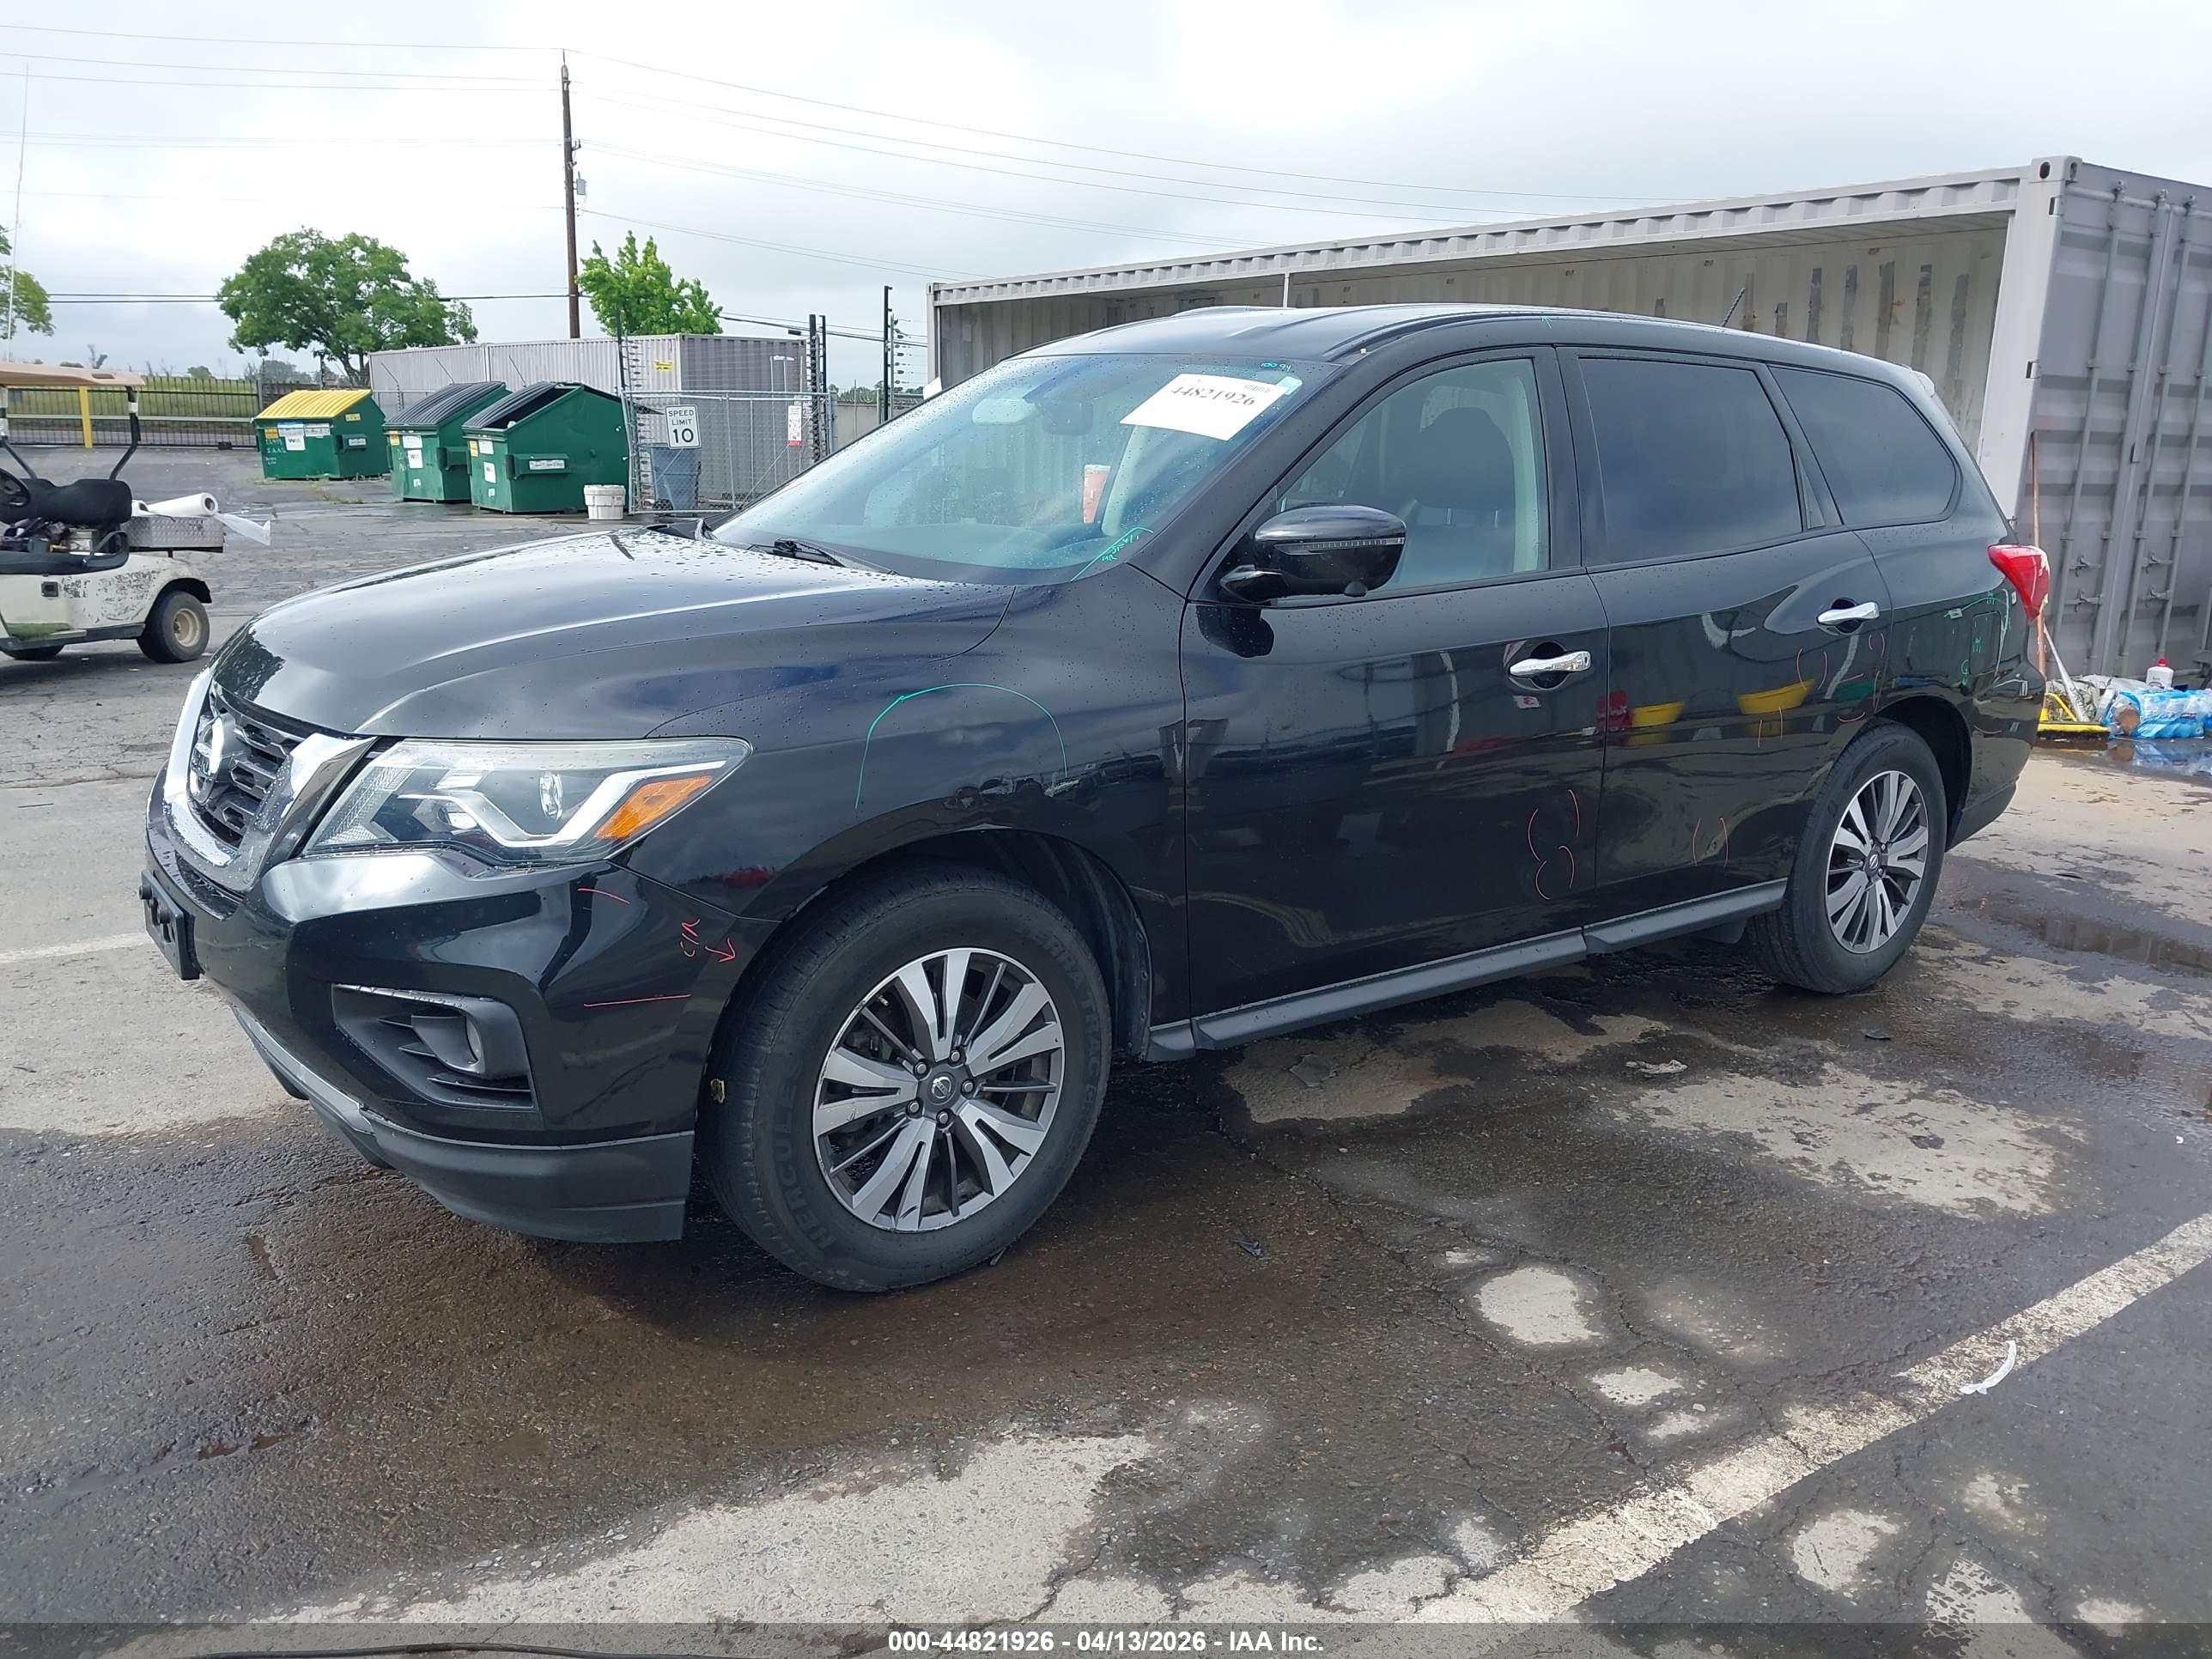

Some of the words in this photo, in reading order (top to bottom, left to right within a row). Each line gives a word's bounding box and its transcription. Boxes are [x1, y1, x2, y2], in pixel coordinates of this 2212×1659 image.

[1170, 386, 1255, 406] 44821926
[672, 428, 694, 443] 10
[773, 1055, 839, 1251] HERCULES
